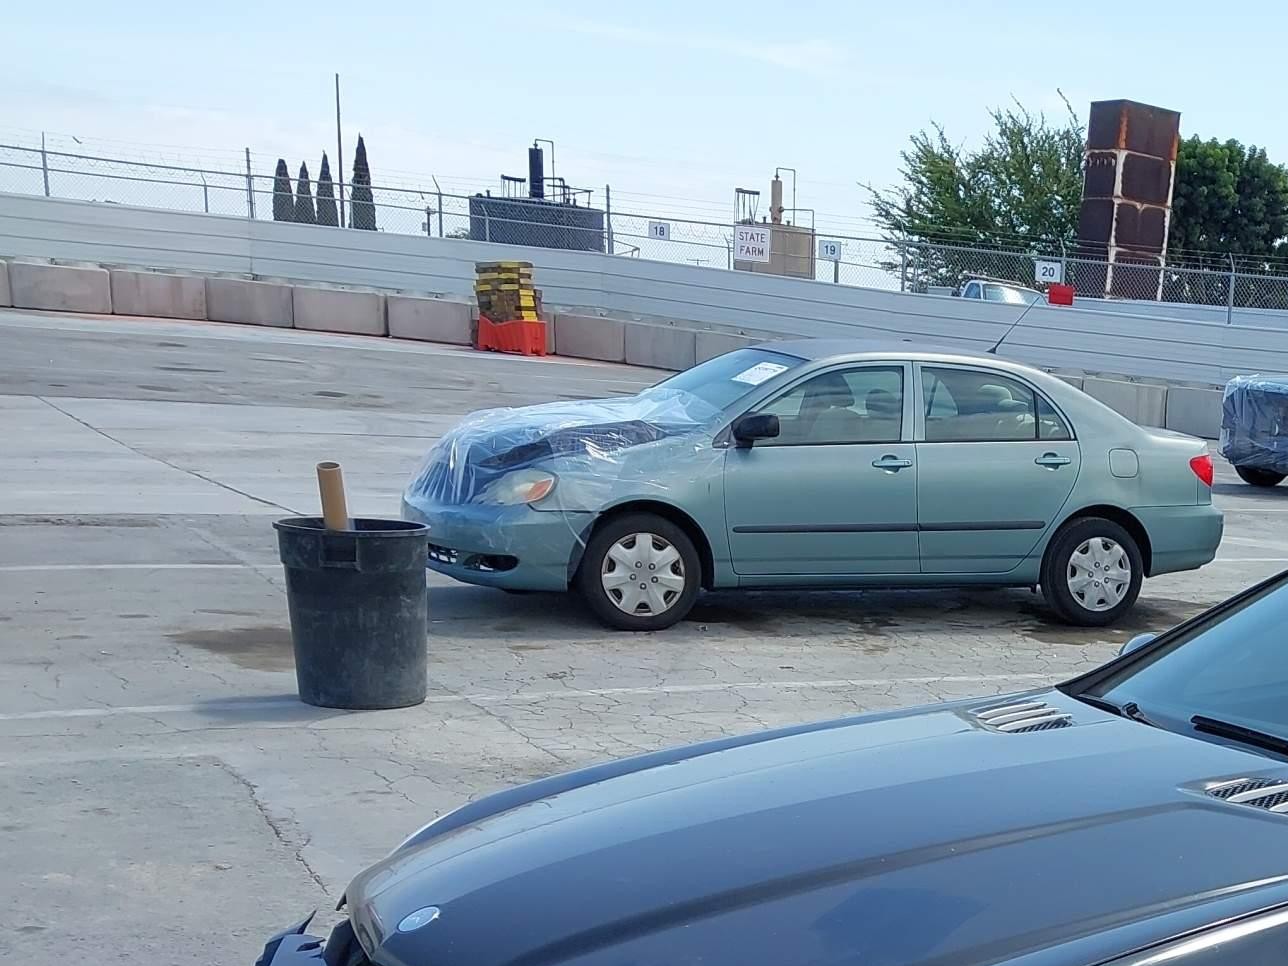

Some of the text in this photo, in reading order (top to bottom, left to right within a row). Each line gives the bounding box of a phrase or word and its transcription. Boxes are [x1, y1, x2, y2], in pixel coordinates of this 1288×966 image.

[654, 225, 665, 237] 18
[739, 231, 766, 244] STATE
[739, 245, 764, 257] FARM
[823, 244, 836, 255] 19
[1041, 266, 1055, 278] 20
